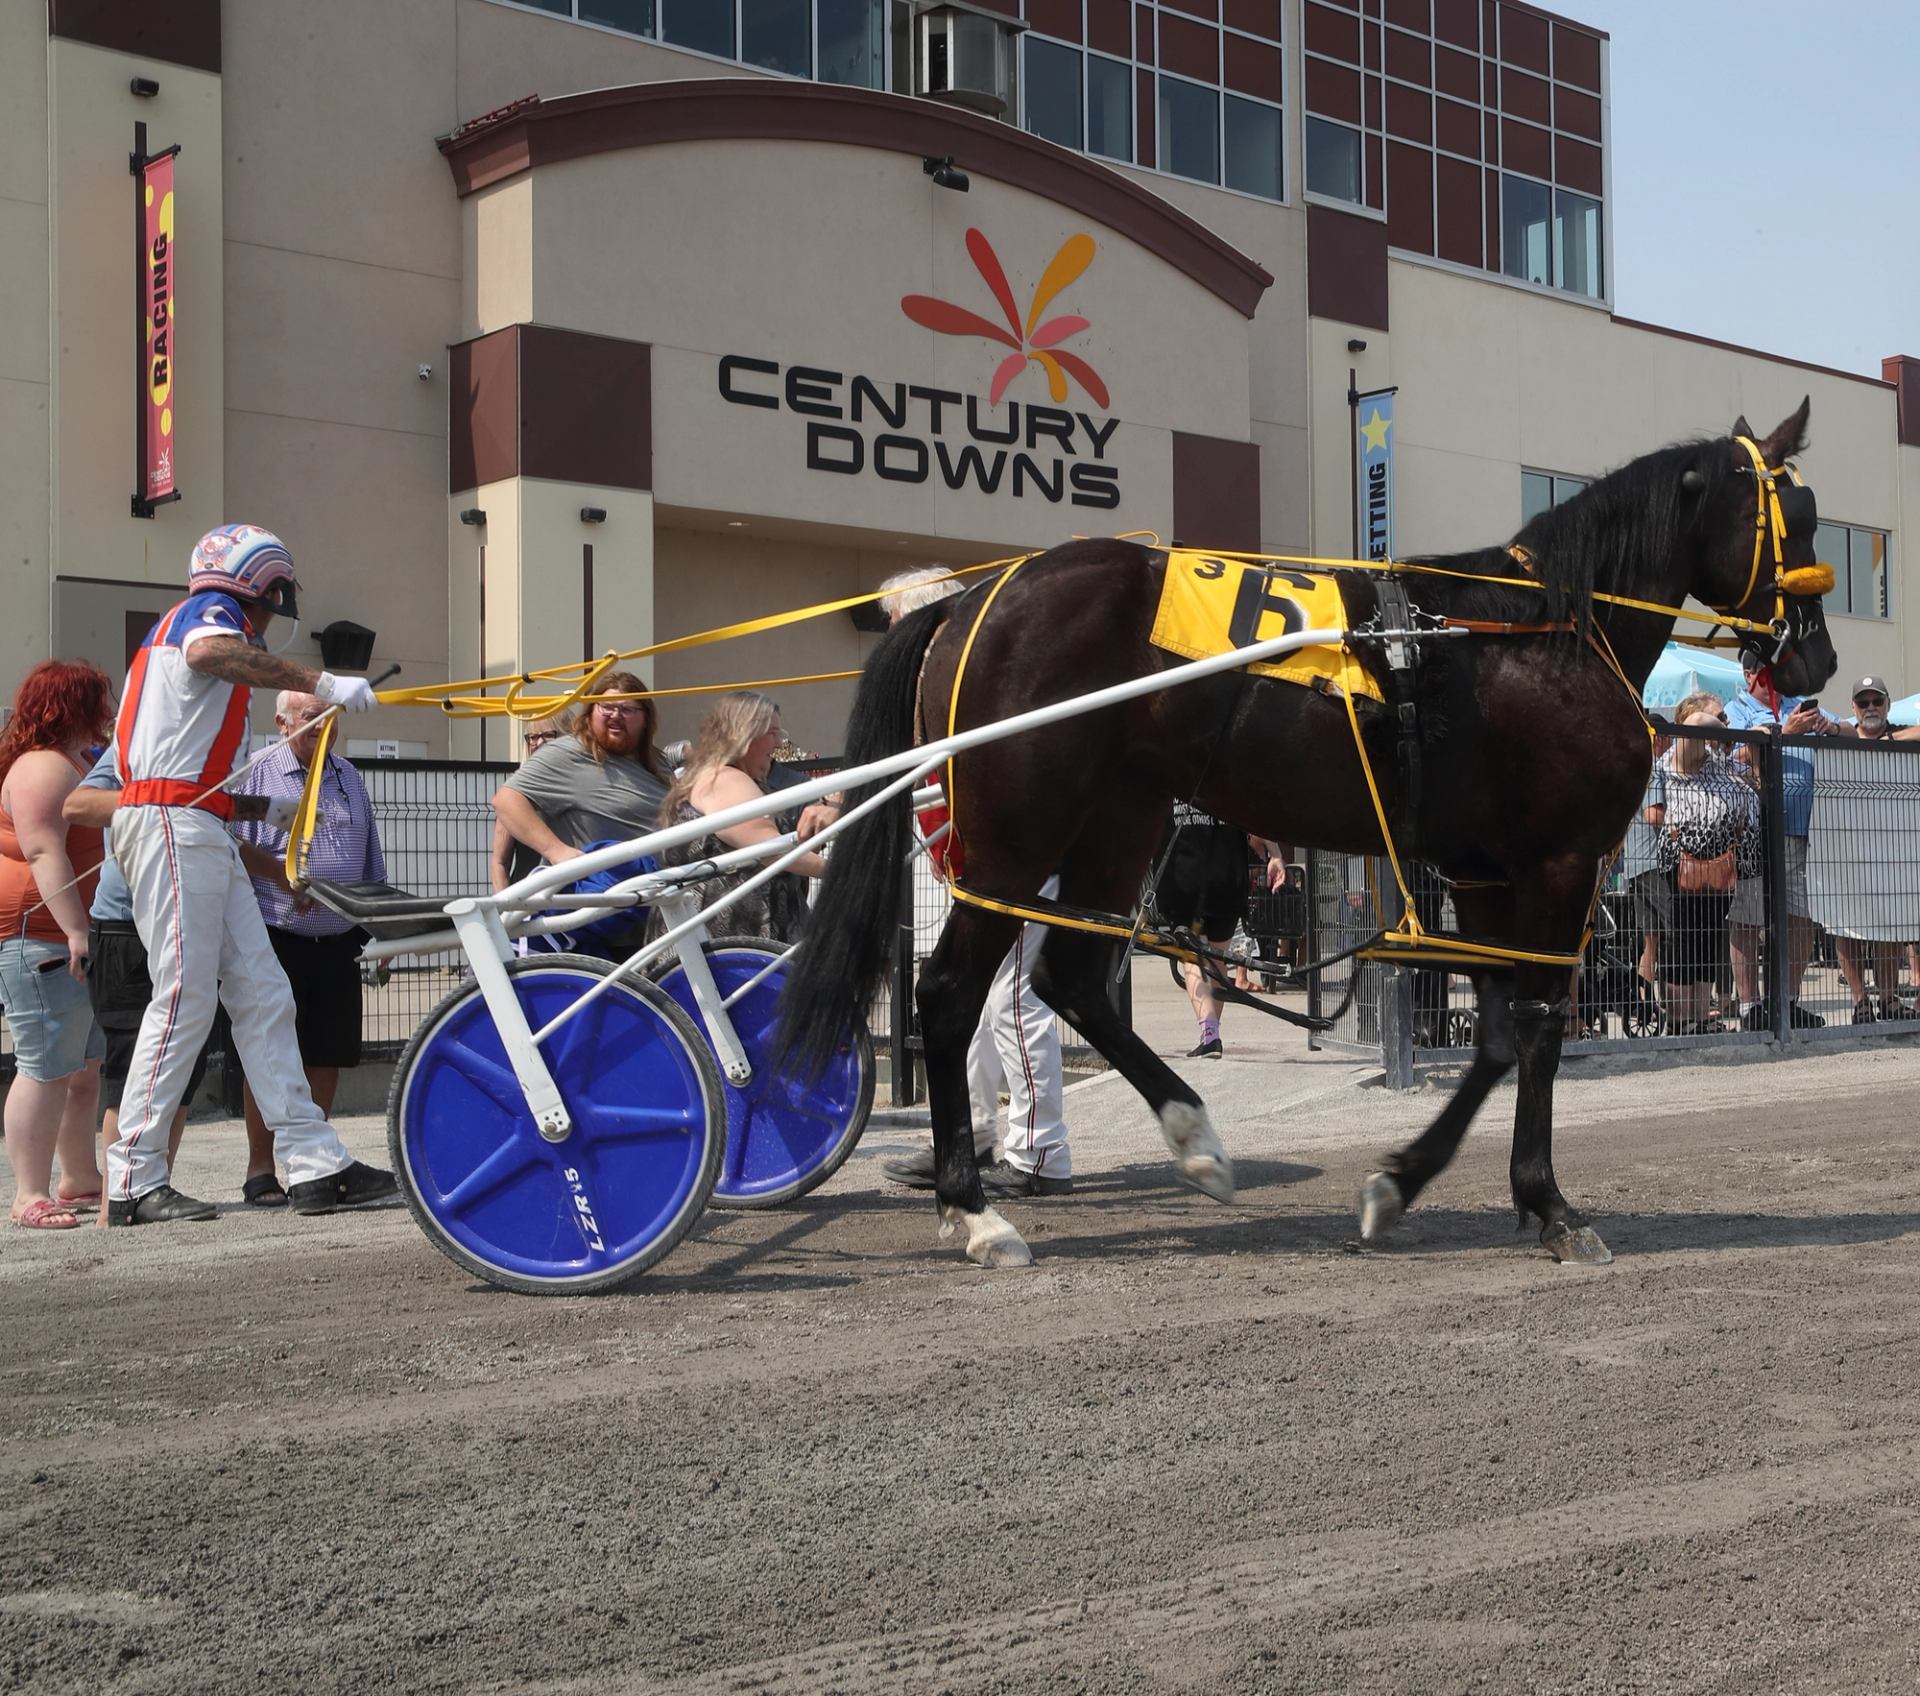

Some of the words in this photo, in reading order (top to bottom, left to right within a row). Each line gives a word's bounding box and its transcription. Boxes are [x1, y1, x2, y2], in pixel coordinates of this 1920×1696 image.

[153, 232, 168, 388] RACING
[718, 354, 1121, 460] CENTURY
[806, 421, 1121, 510] DOWNS
[1368, 462, 1387, 562] ETTING
[1193, 558, 1228, 580] 3
[1227, 567, 1317, 665] 6
